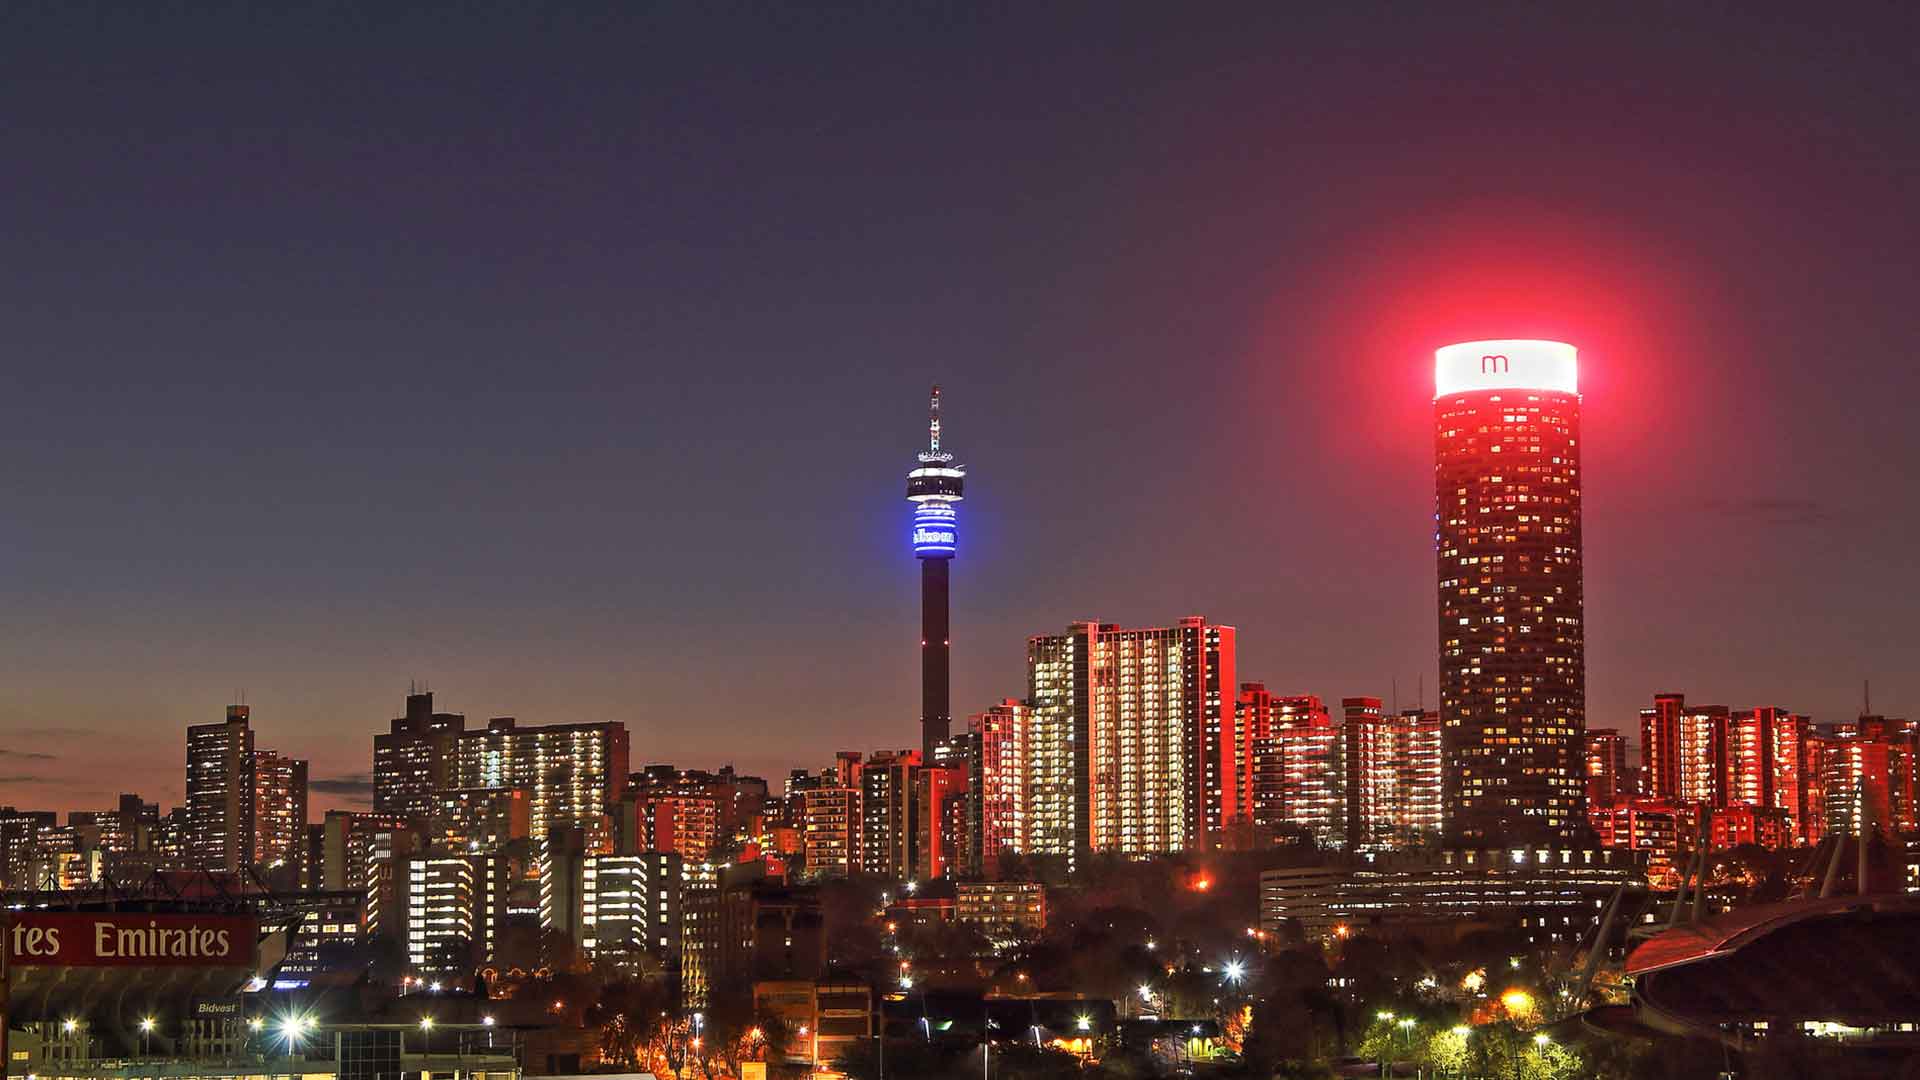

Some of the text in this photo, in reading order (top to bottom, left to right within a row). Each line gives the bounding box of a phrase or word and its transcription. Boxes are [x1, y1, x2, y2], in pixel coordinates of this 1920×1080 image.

[1482, 355, 1508, 373] m
[12, 920, 230, 957] tes Emirates
[198, 1003, 236, 1013] Bidvest
